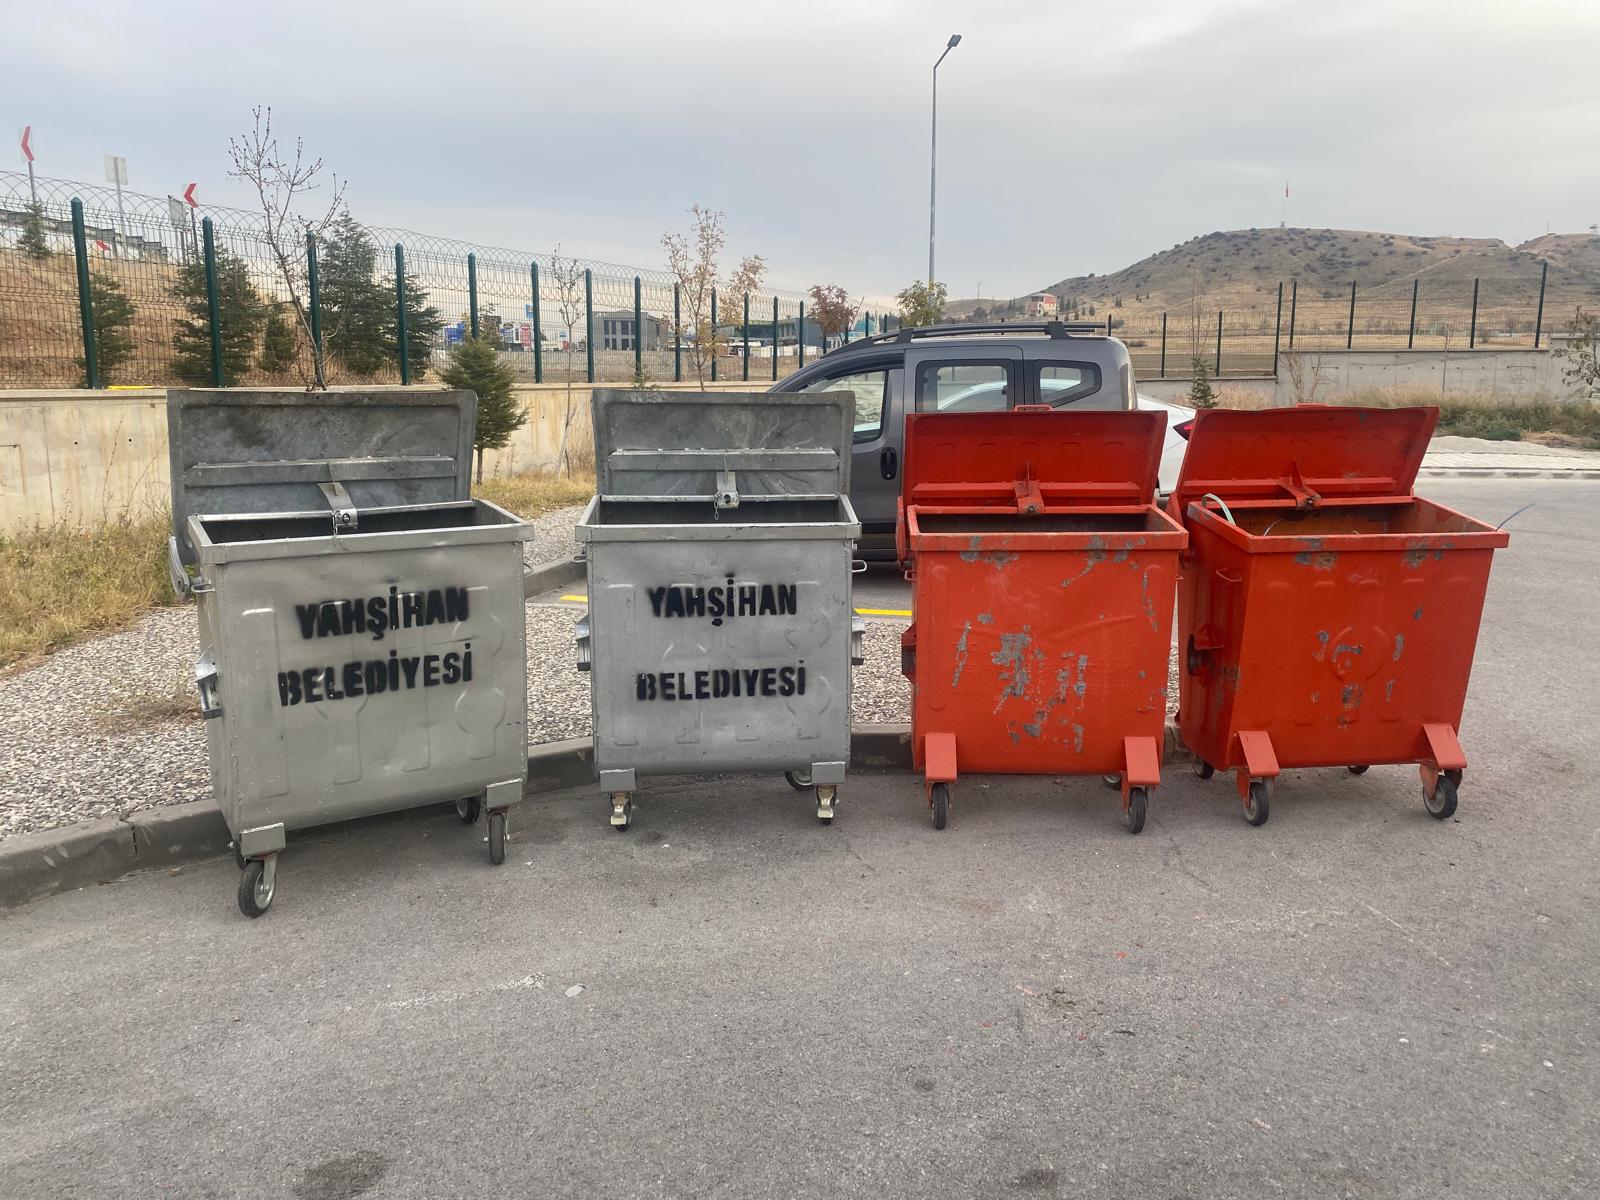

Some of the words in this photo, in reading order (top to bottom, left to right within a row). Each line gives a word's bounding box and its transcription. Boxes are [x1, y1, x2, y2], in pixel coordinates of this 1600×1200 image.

[295, 586, 469, 640] YAHŞİHAN
[648, 578, 797, 626] YAHŞİHAN
[278, 643, 473, 706] BELEDİYESİ
